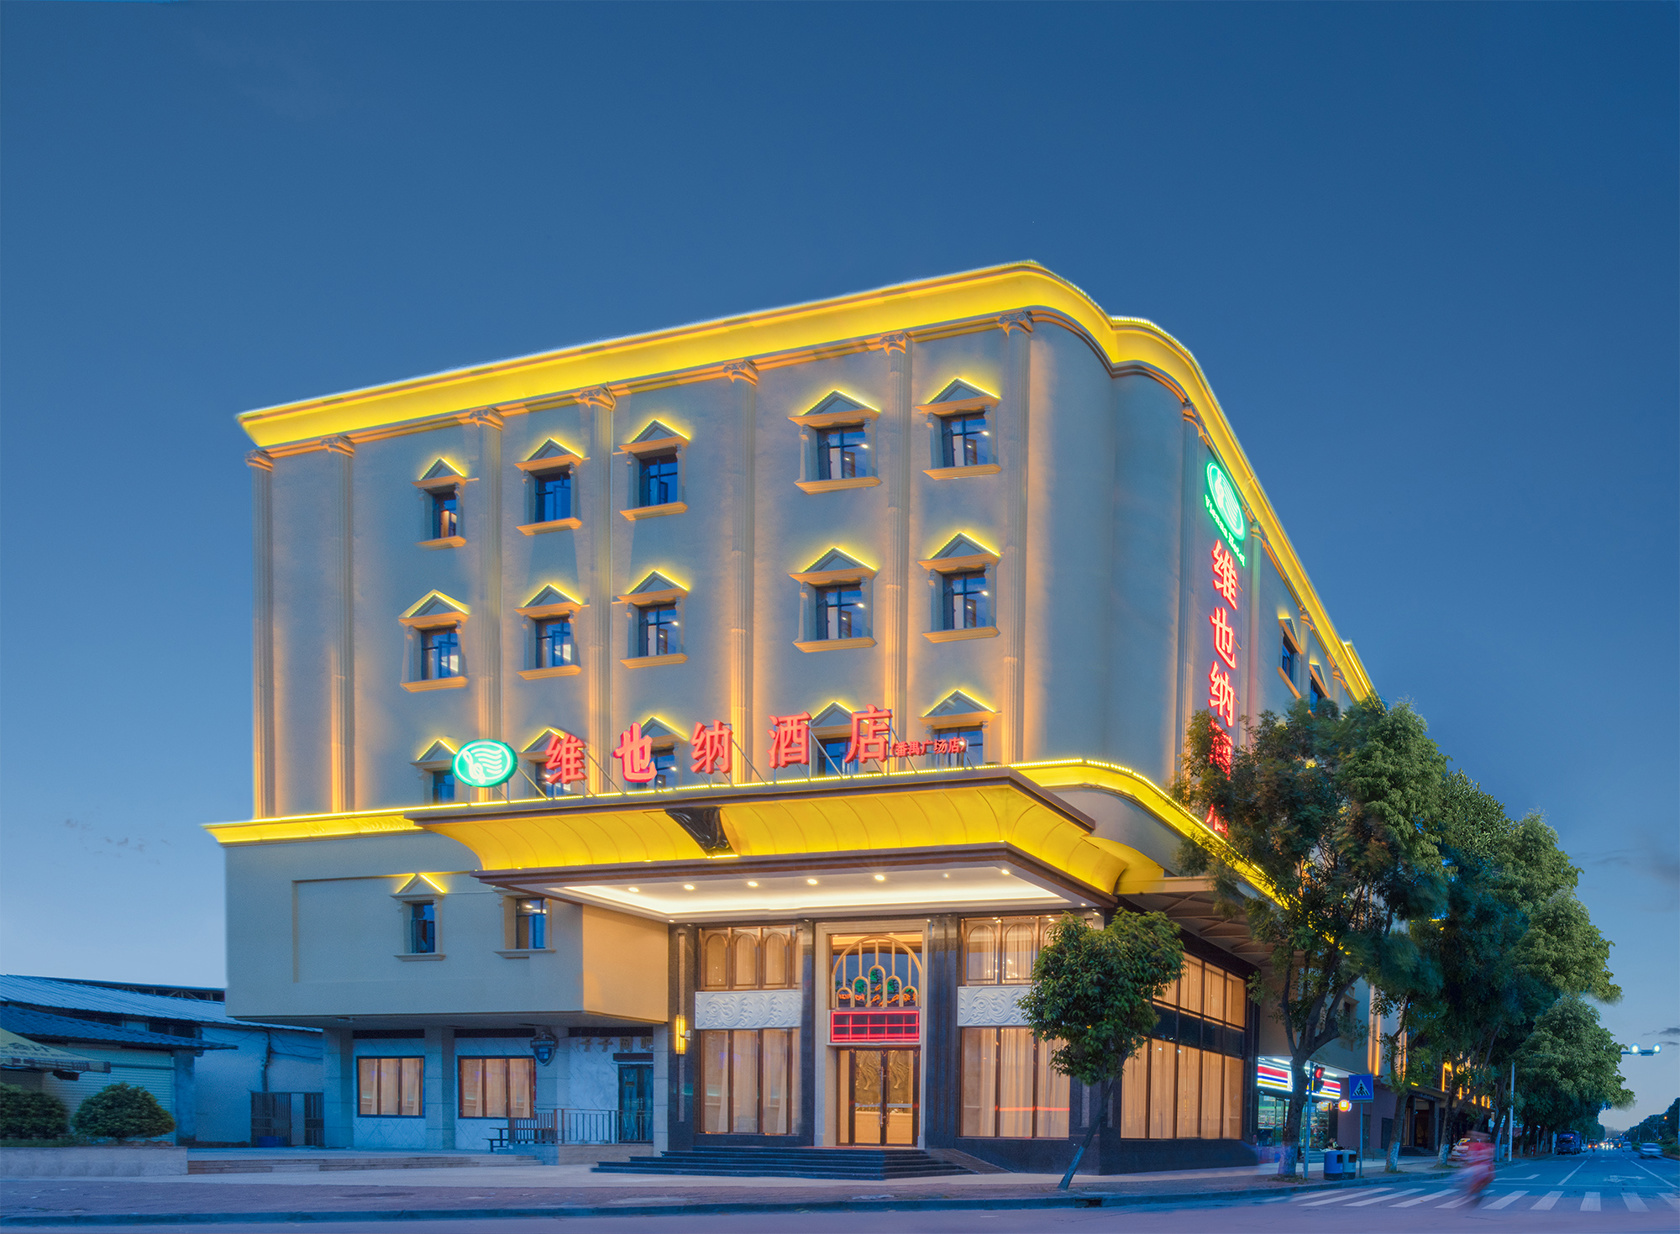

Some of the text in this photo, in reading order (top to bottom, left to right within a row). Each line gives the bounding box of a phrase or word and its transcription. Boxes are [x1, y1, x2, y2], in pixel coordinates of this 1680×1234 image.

[545, 704, 892, 785] 维也纳酒店
